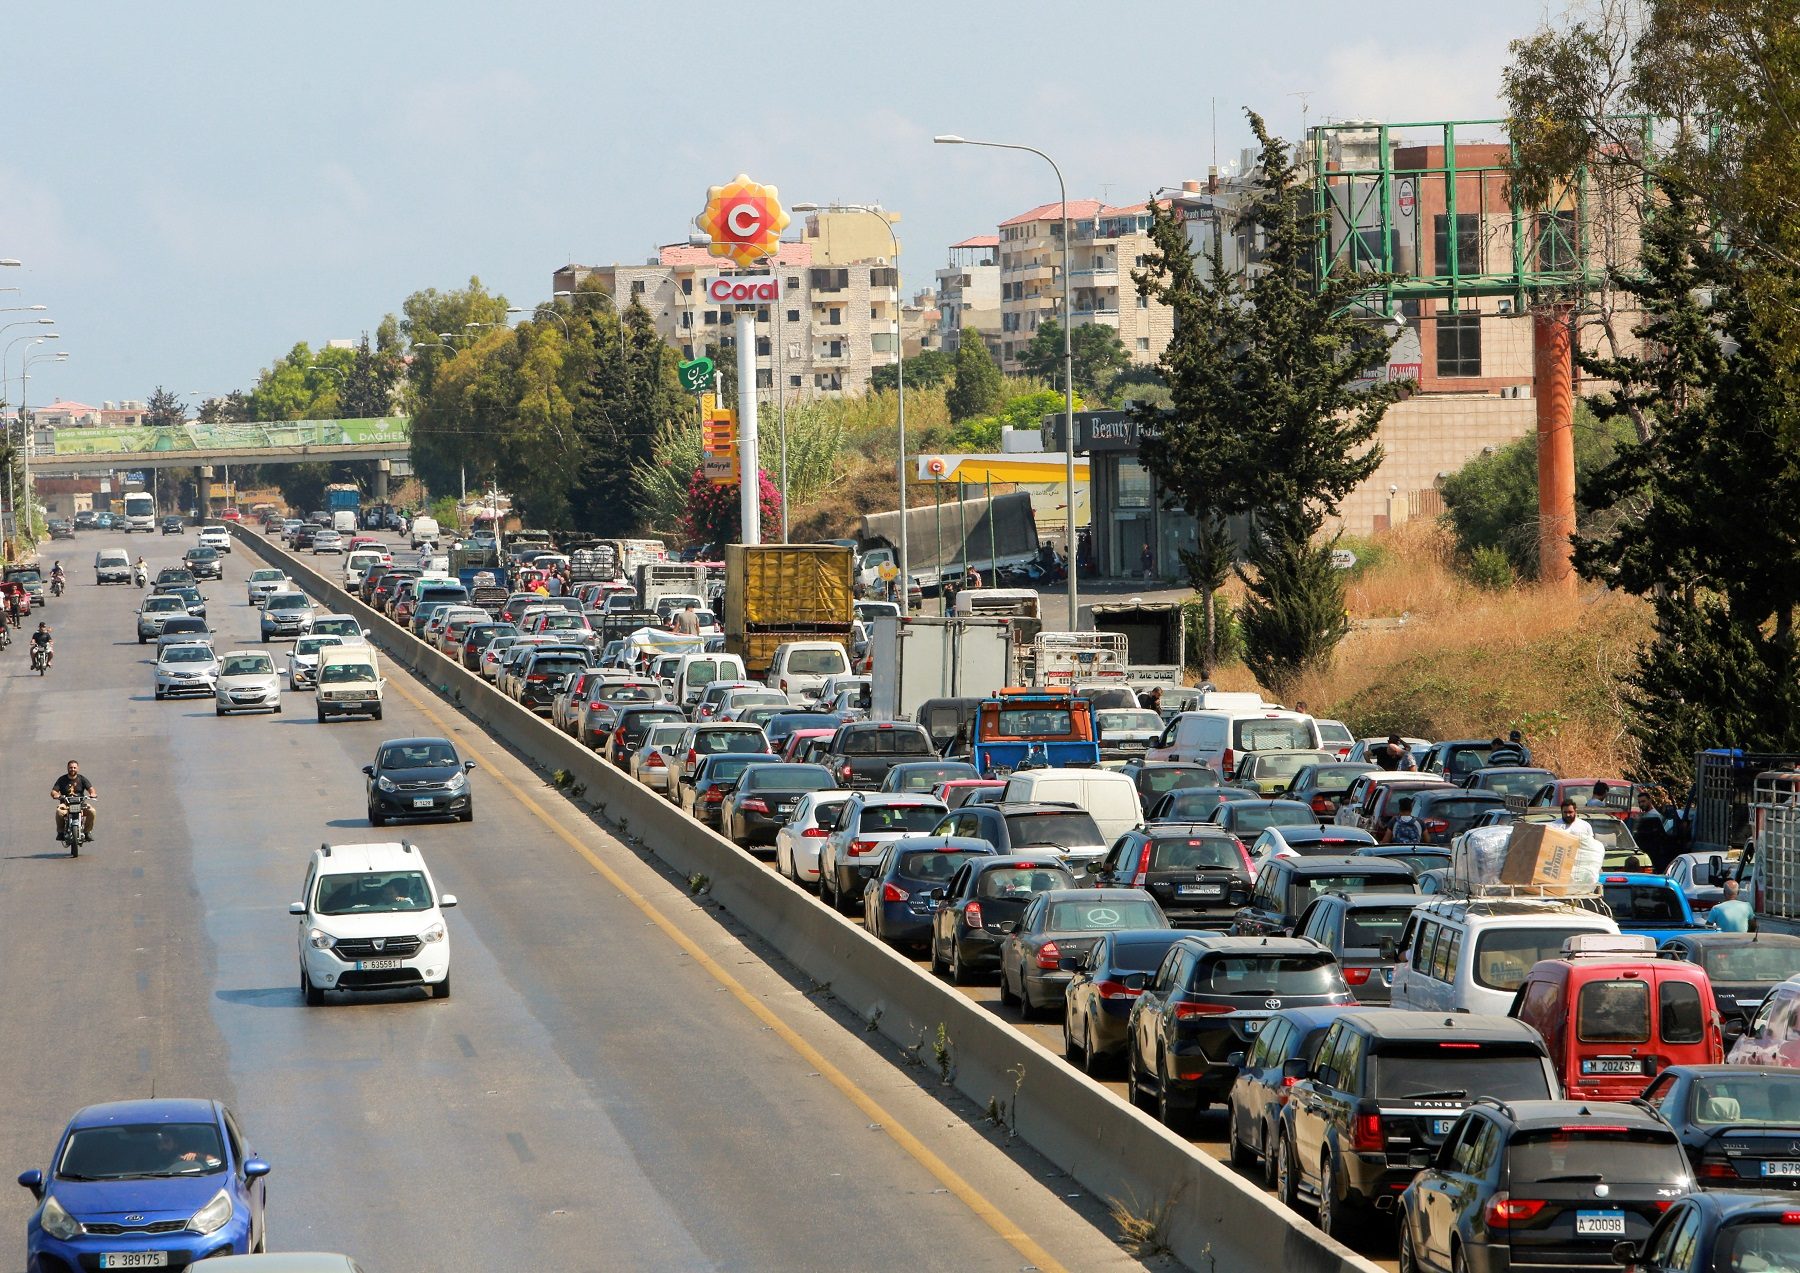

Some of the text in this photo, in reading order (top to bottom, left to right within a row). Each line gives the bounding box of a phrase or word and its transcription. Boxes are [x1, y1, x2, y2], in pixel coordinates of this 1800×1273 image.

[728, 203, 760, 237] C
[711, 279, 779, 301] Coral
[359, 431, 405, 441] DAGHER
[1091, 417, 1132, 445] Beauty
[1590, 1061, 1636, 1072] M 202437
[1442, 1121, 1449, 1132] G
[1769, 1163, 1776, 1174] B
[1579, 1219, 1621, 1231] A 20098
[109, 1254, 160, 1266] G 389175
